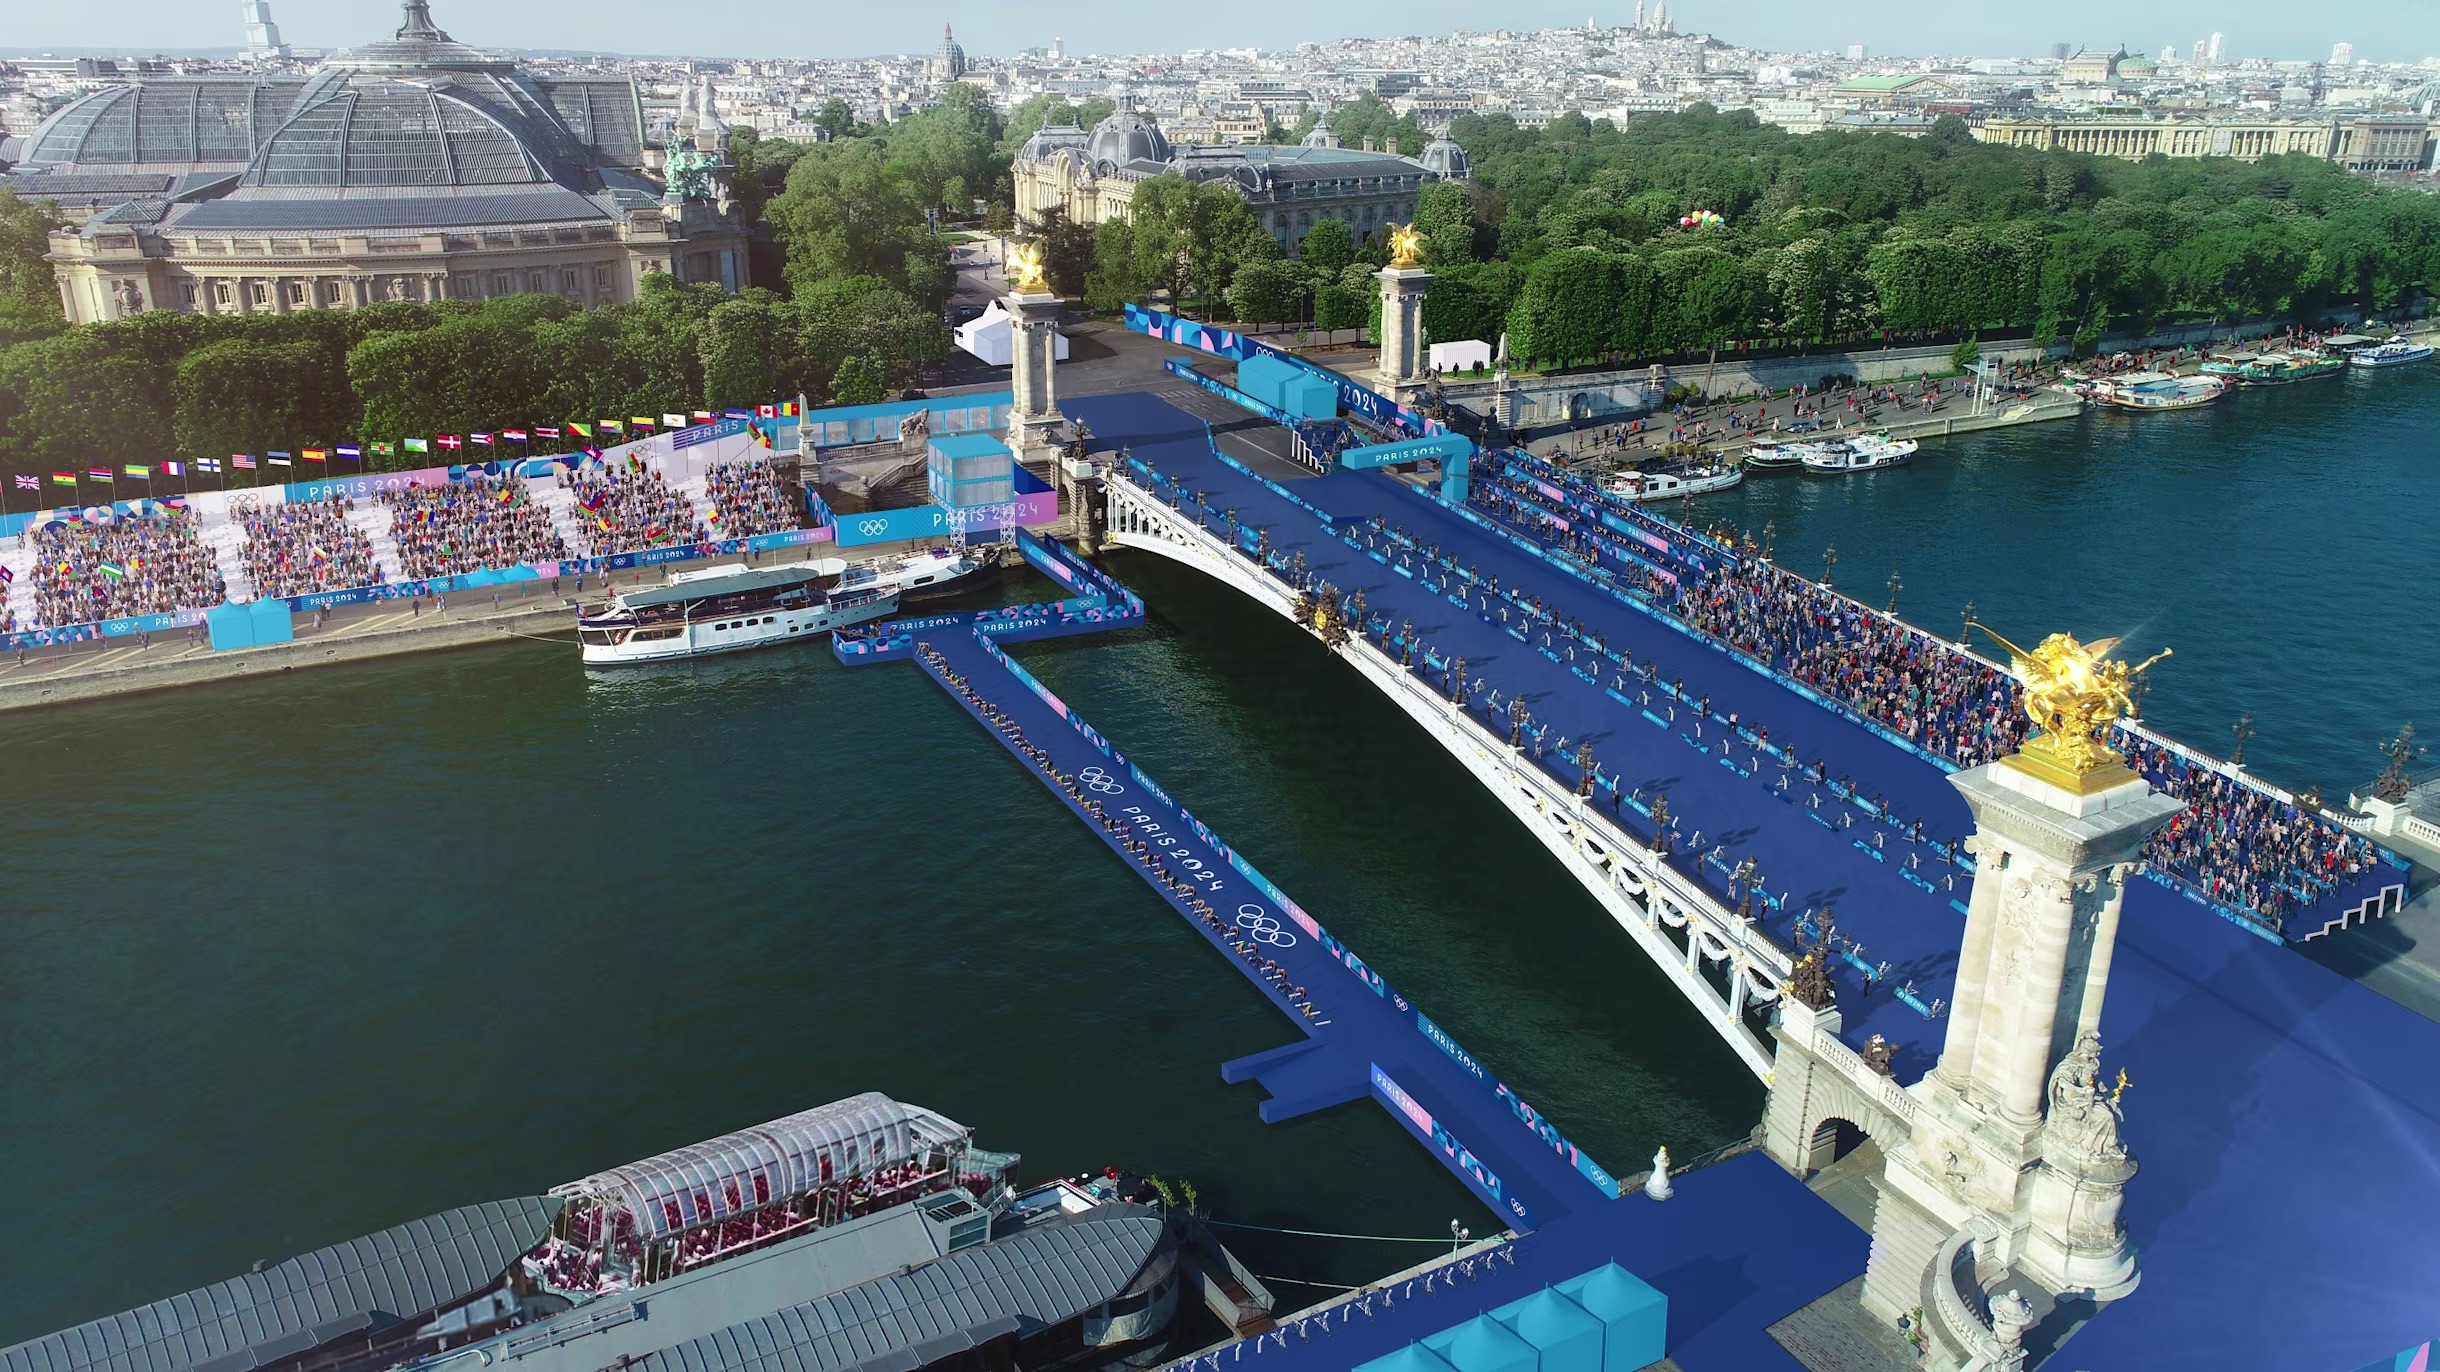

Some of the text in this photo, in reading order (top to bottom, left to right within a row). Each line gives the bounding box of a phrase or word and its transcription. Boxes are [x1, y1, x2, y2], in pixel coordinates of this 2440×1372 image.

[1343, 384, 1377, 415] 2024
[693, 420, 739, 441] PARIS
[1375, 446, 1442, 462] PARIS 2024
[309, 481, 367, 498] PARIS
[933, 510, 985, 527] PARIS
[784, 531, 824, 543] PARIS 2024
[1627, 526, 1645, 541] PARIS
[646, 550, 685, 561] ARIS 2024
[310, 593, 357, 606] PARIS 2024
[155, 614, 188, 627] PAIS
[891, 617, 959, 631] PARIS 2024
[983, 619, 1047, 632] PARIS 2024
[1137, 771, 1156, 792] PARIS
[1122, 805, 1224, 892] PARIS 2024
[1267, 884, 1311, 928] PARIS 2024
[1427, 1024, 1484, 1078] PARIS 2024
[1377, 1072, 1424, 1123] PARIS 2024
